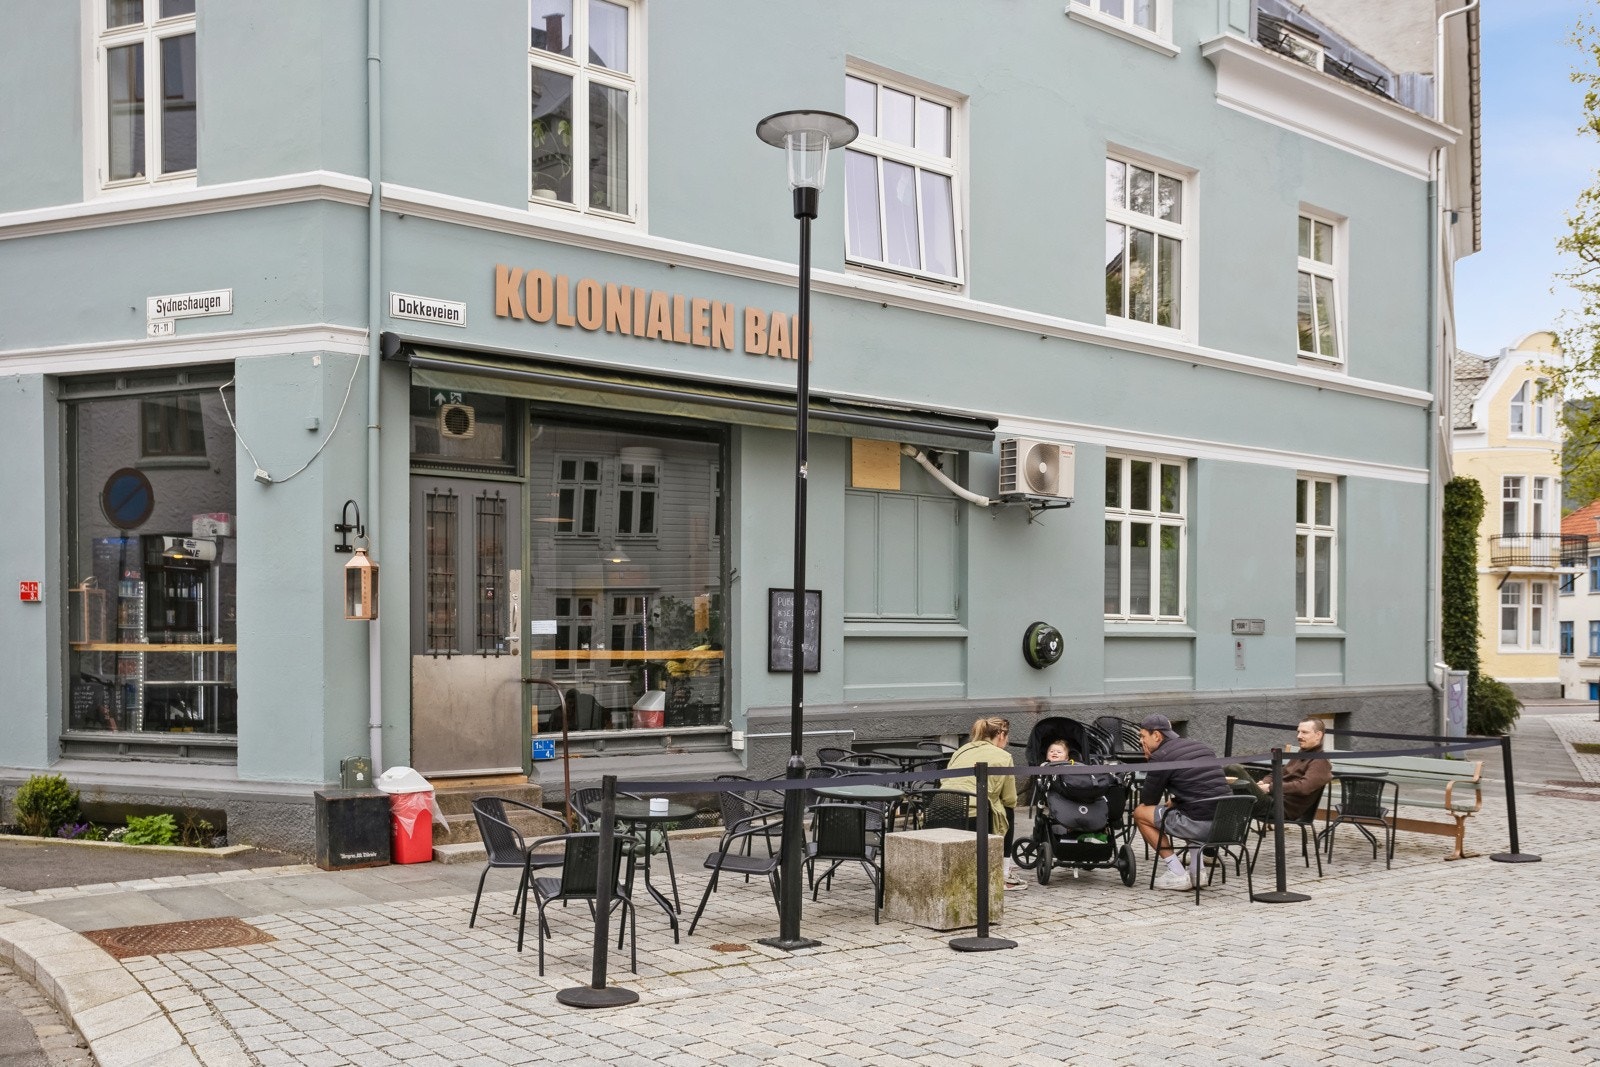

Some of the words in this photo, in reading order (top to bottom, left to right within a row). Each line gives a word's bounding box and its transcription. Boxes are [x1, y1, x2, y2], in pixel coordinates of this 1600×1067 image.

[156, 296, 221, 316] Sydneshaugen
[398, 298, 459, 320] Dokkeveien
[495, 263, 735, 350] KOLONIALEN
